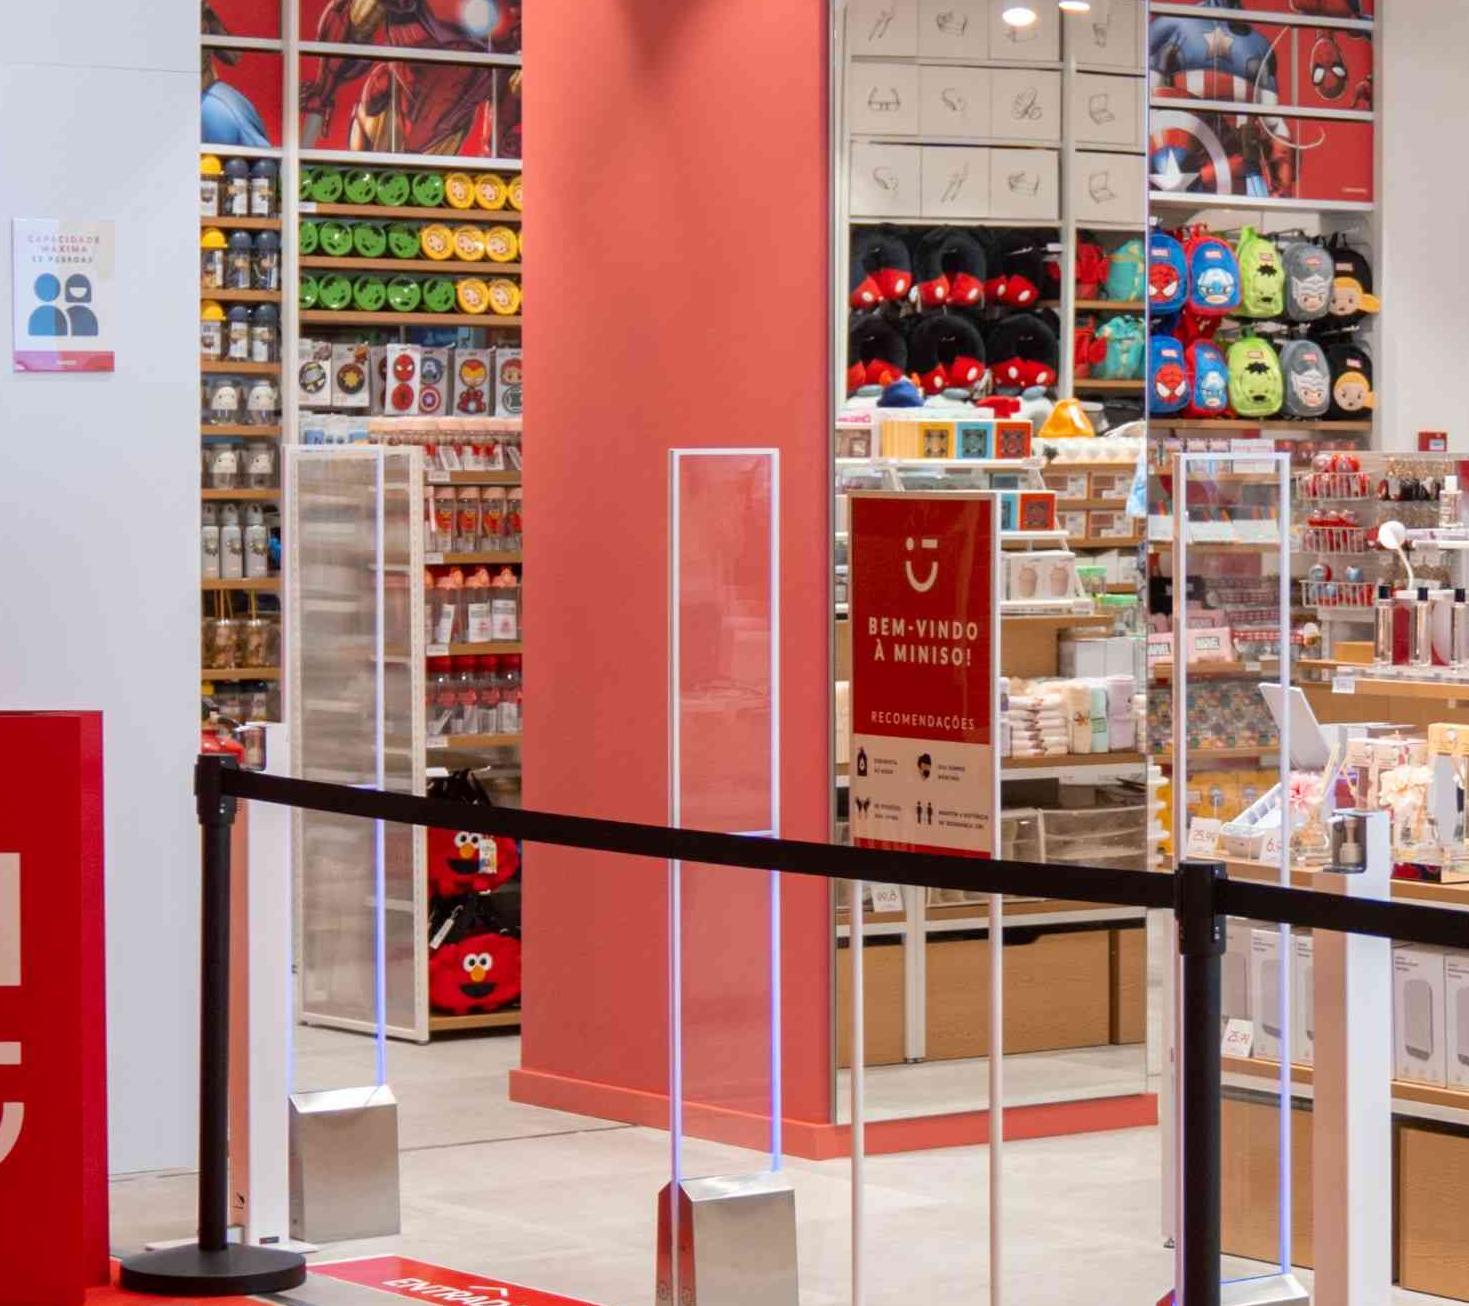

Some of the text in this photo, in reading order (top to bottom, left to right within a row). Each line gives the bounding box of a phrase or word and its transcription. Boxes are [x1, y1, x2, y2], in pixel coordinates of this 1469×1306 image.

[868, 616, 979, 641] BEM-VINDO
[874, 638, 972, 667] À MINISO!
[870, 710, 975, 731] RECOMENDAÇÕES
